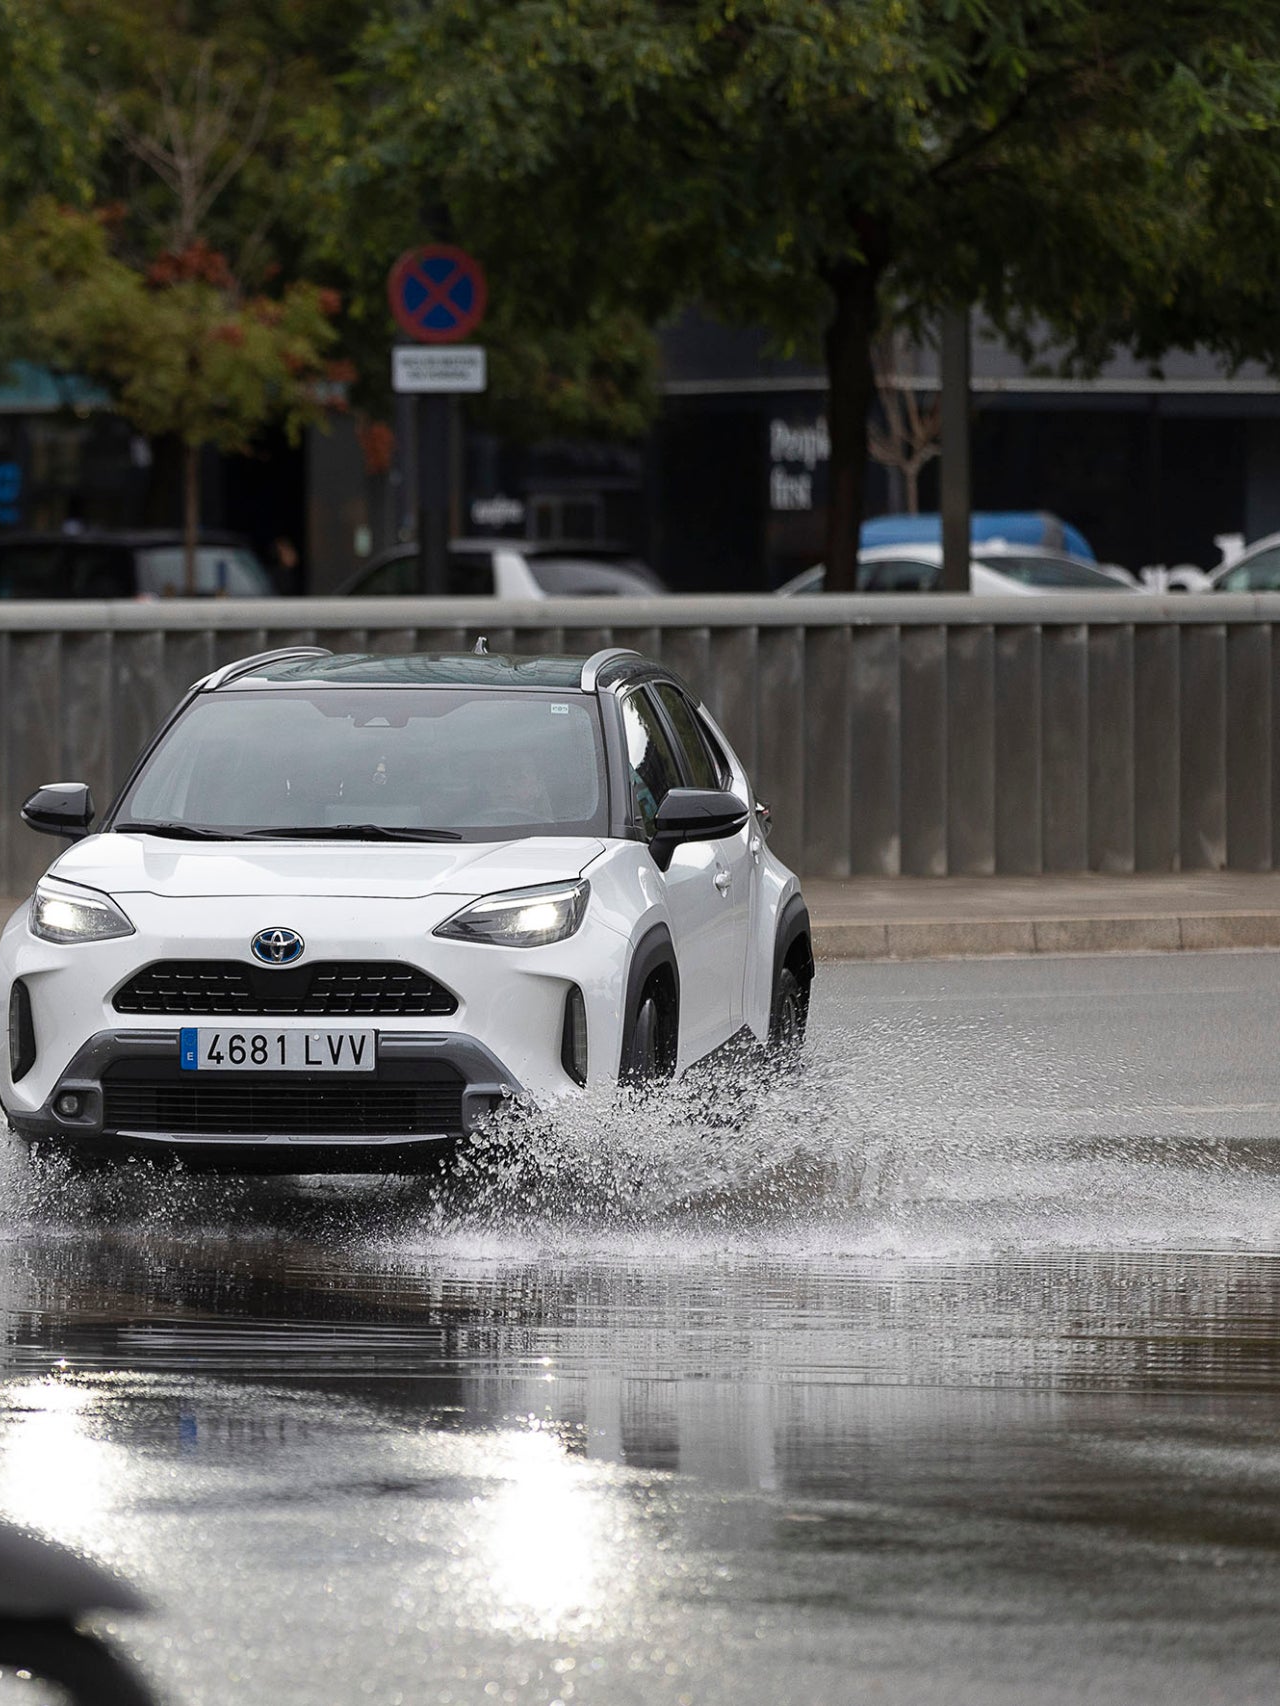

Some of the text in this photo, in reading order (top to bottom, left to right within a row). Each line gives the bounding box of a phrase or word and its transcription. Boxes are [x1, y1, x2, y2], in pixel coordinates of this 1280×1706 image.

[186, 1052, 194, 1061] E
[207, 1034, 366, 1066] 4681 LVV
